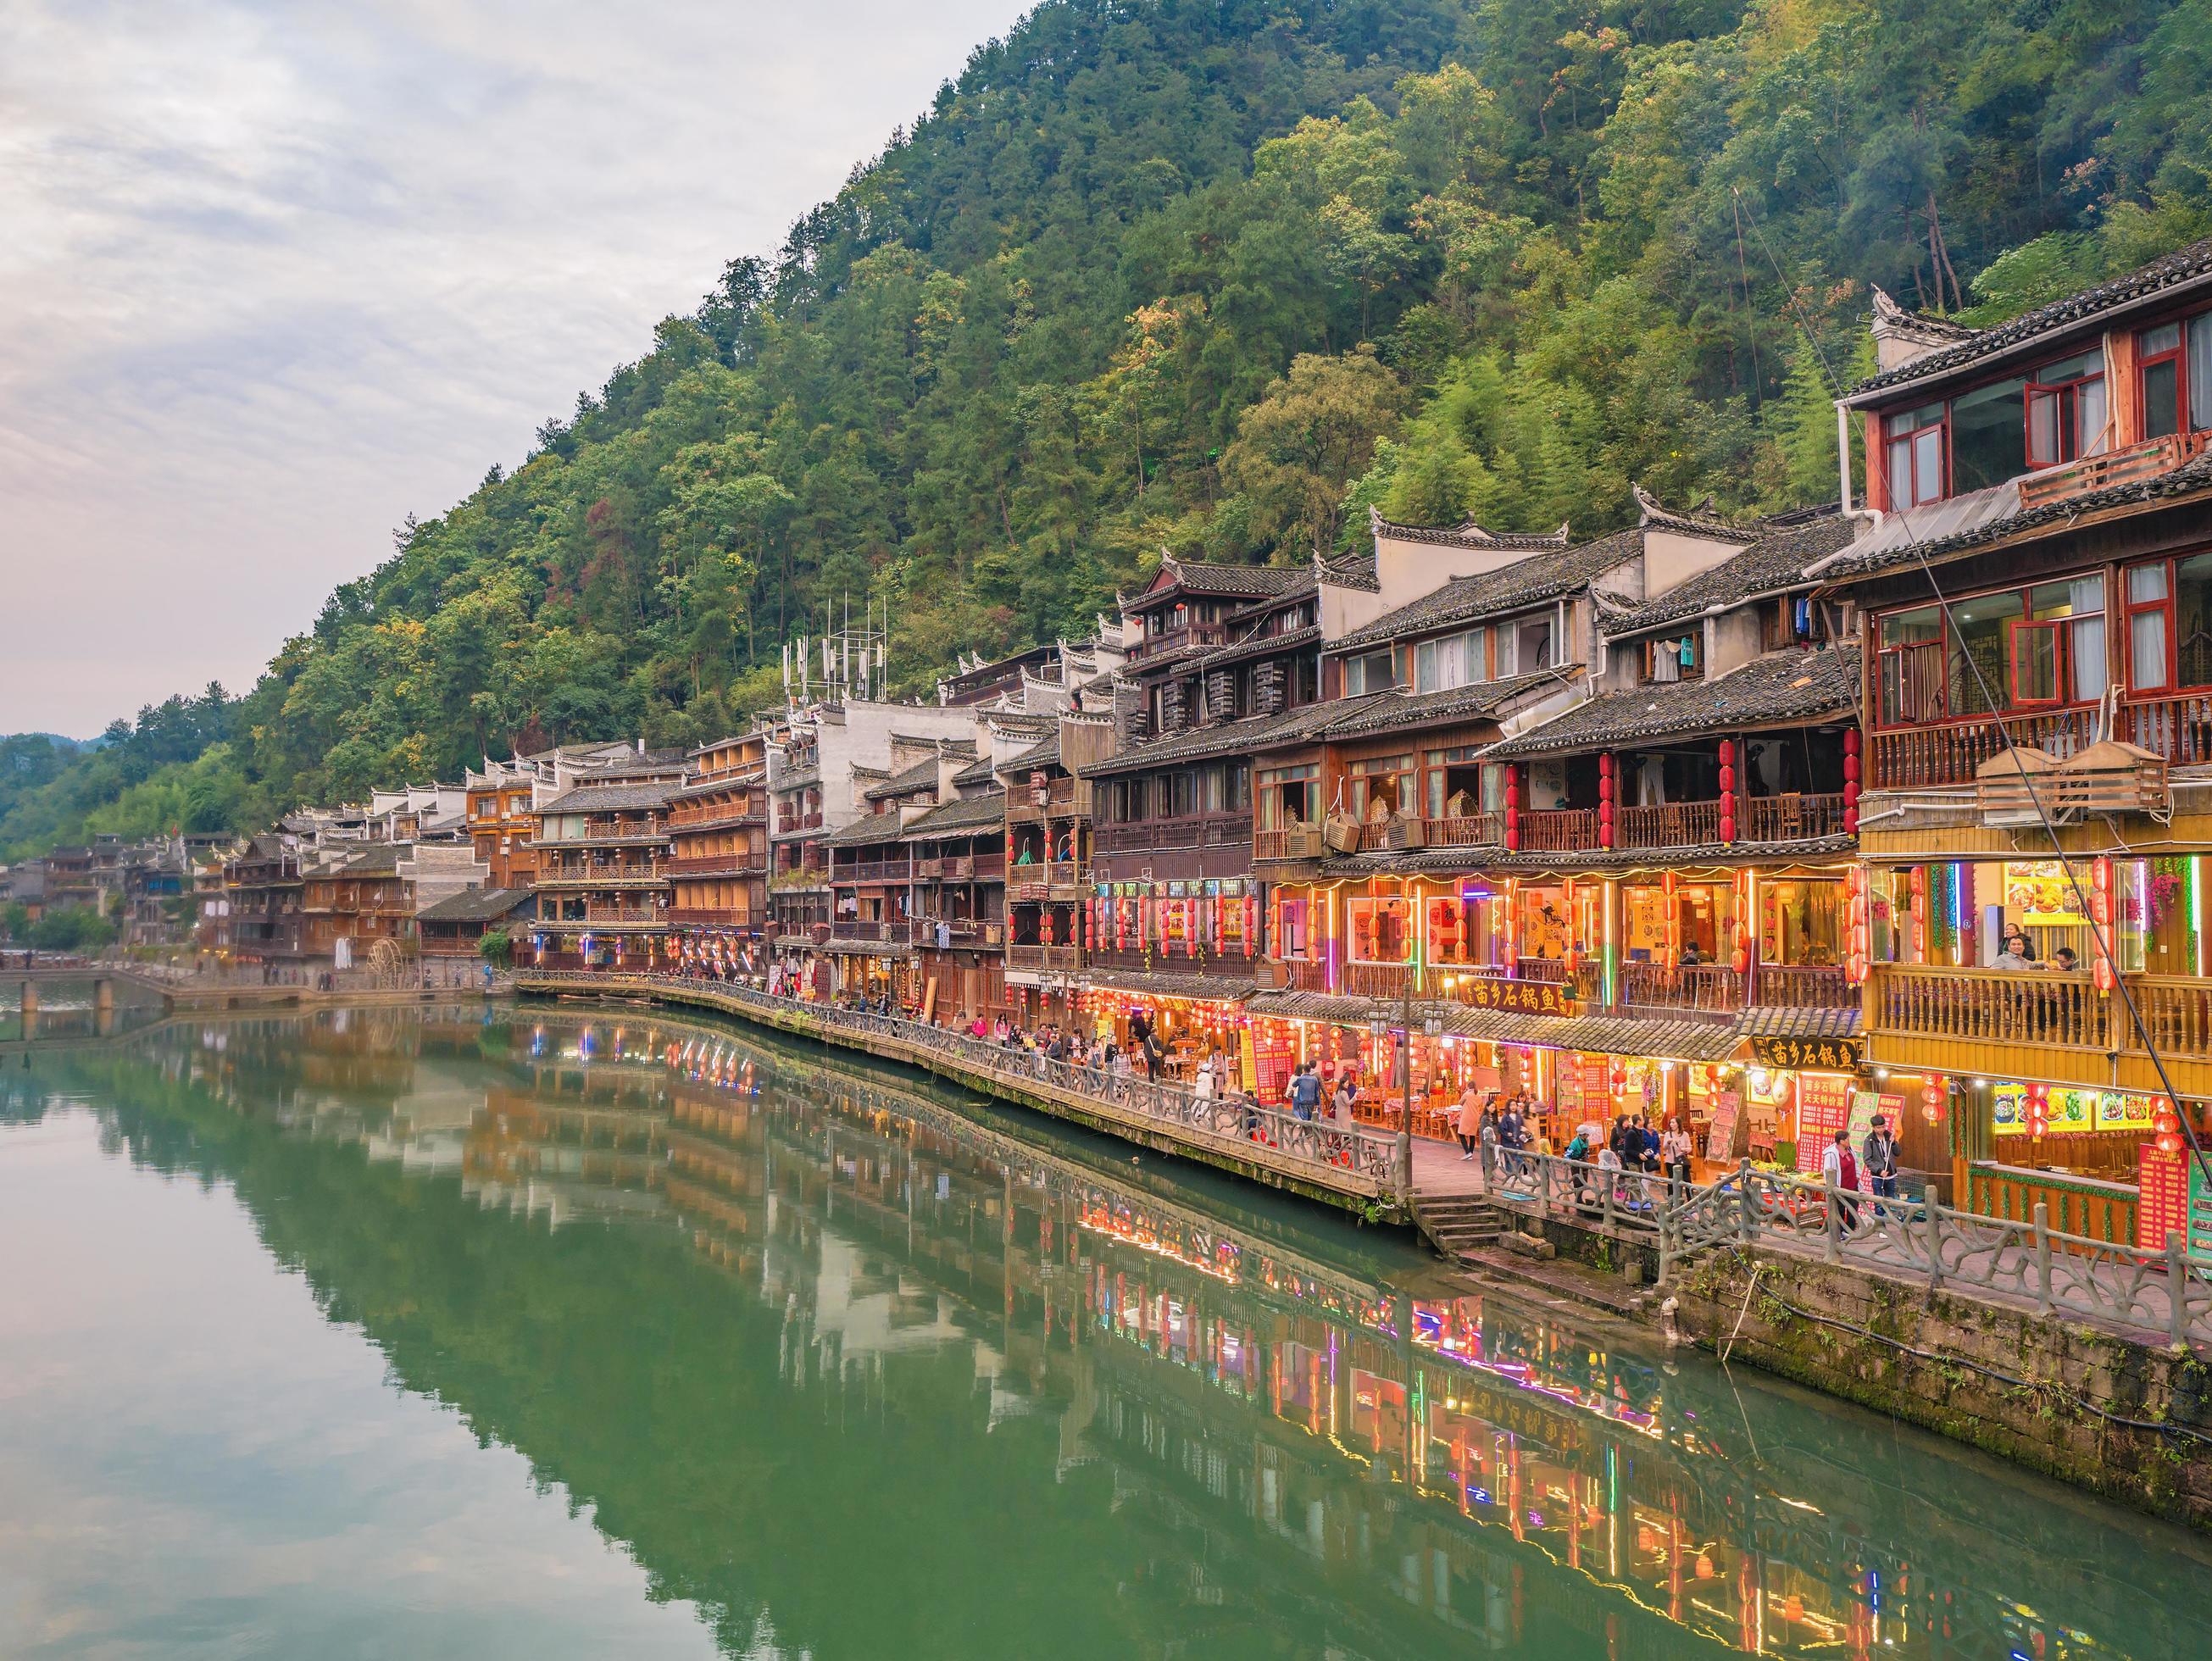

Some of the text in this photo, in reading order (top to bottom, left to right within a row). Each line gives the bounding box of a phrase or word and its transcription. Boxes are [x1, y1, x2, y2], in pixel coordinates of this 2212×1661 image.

[1474, 980, 1559, 1011] 苗乡石锅鱼
[1771, 1040, 1855, 1069] 苗乡石锅鱼
[1805, 1080, 1845, 1095] 苗乡石锅鱼
[1804, 1093, 1844, 1108] 天天特价菜
